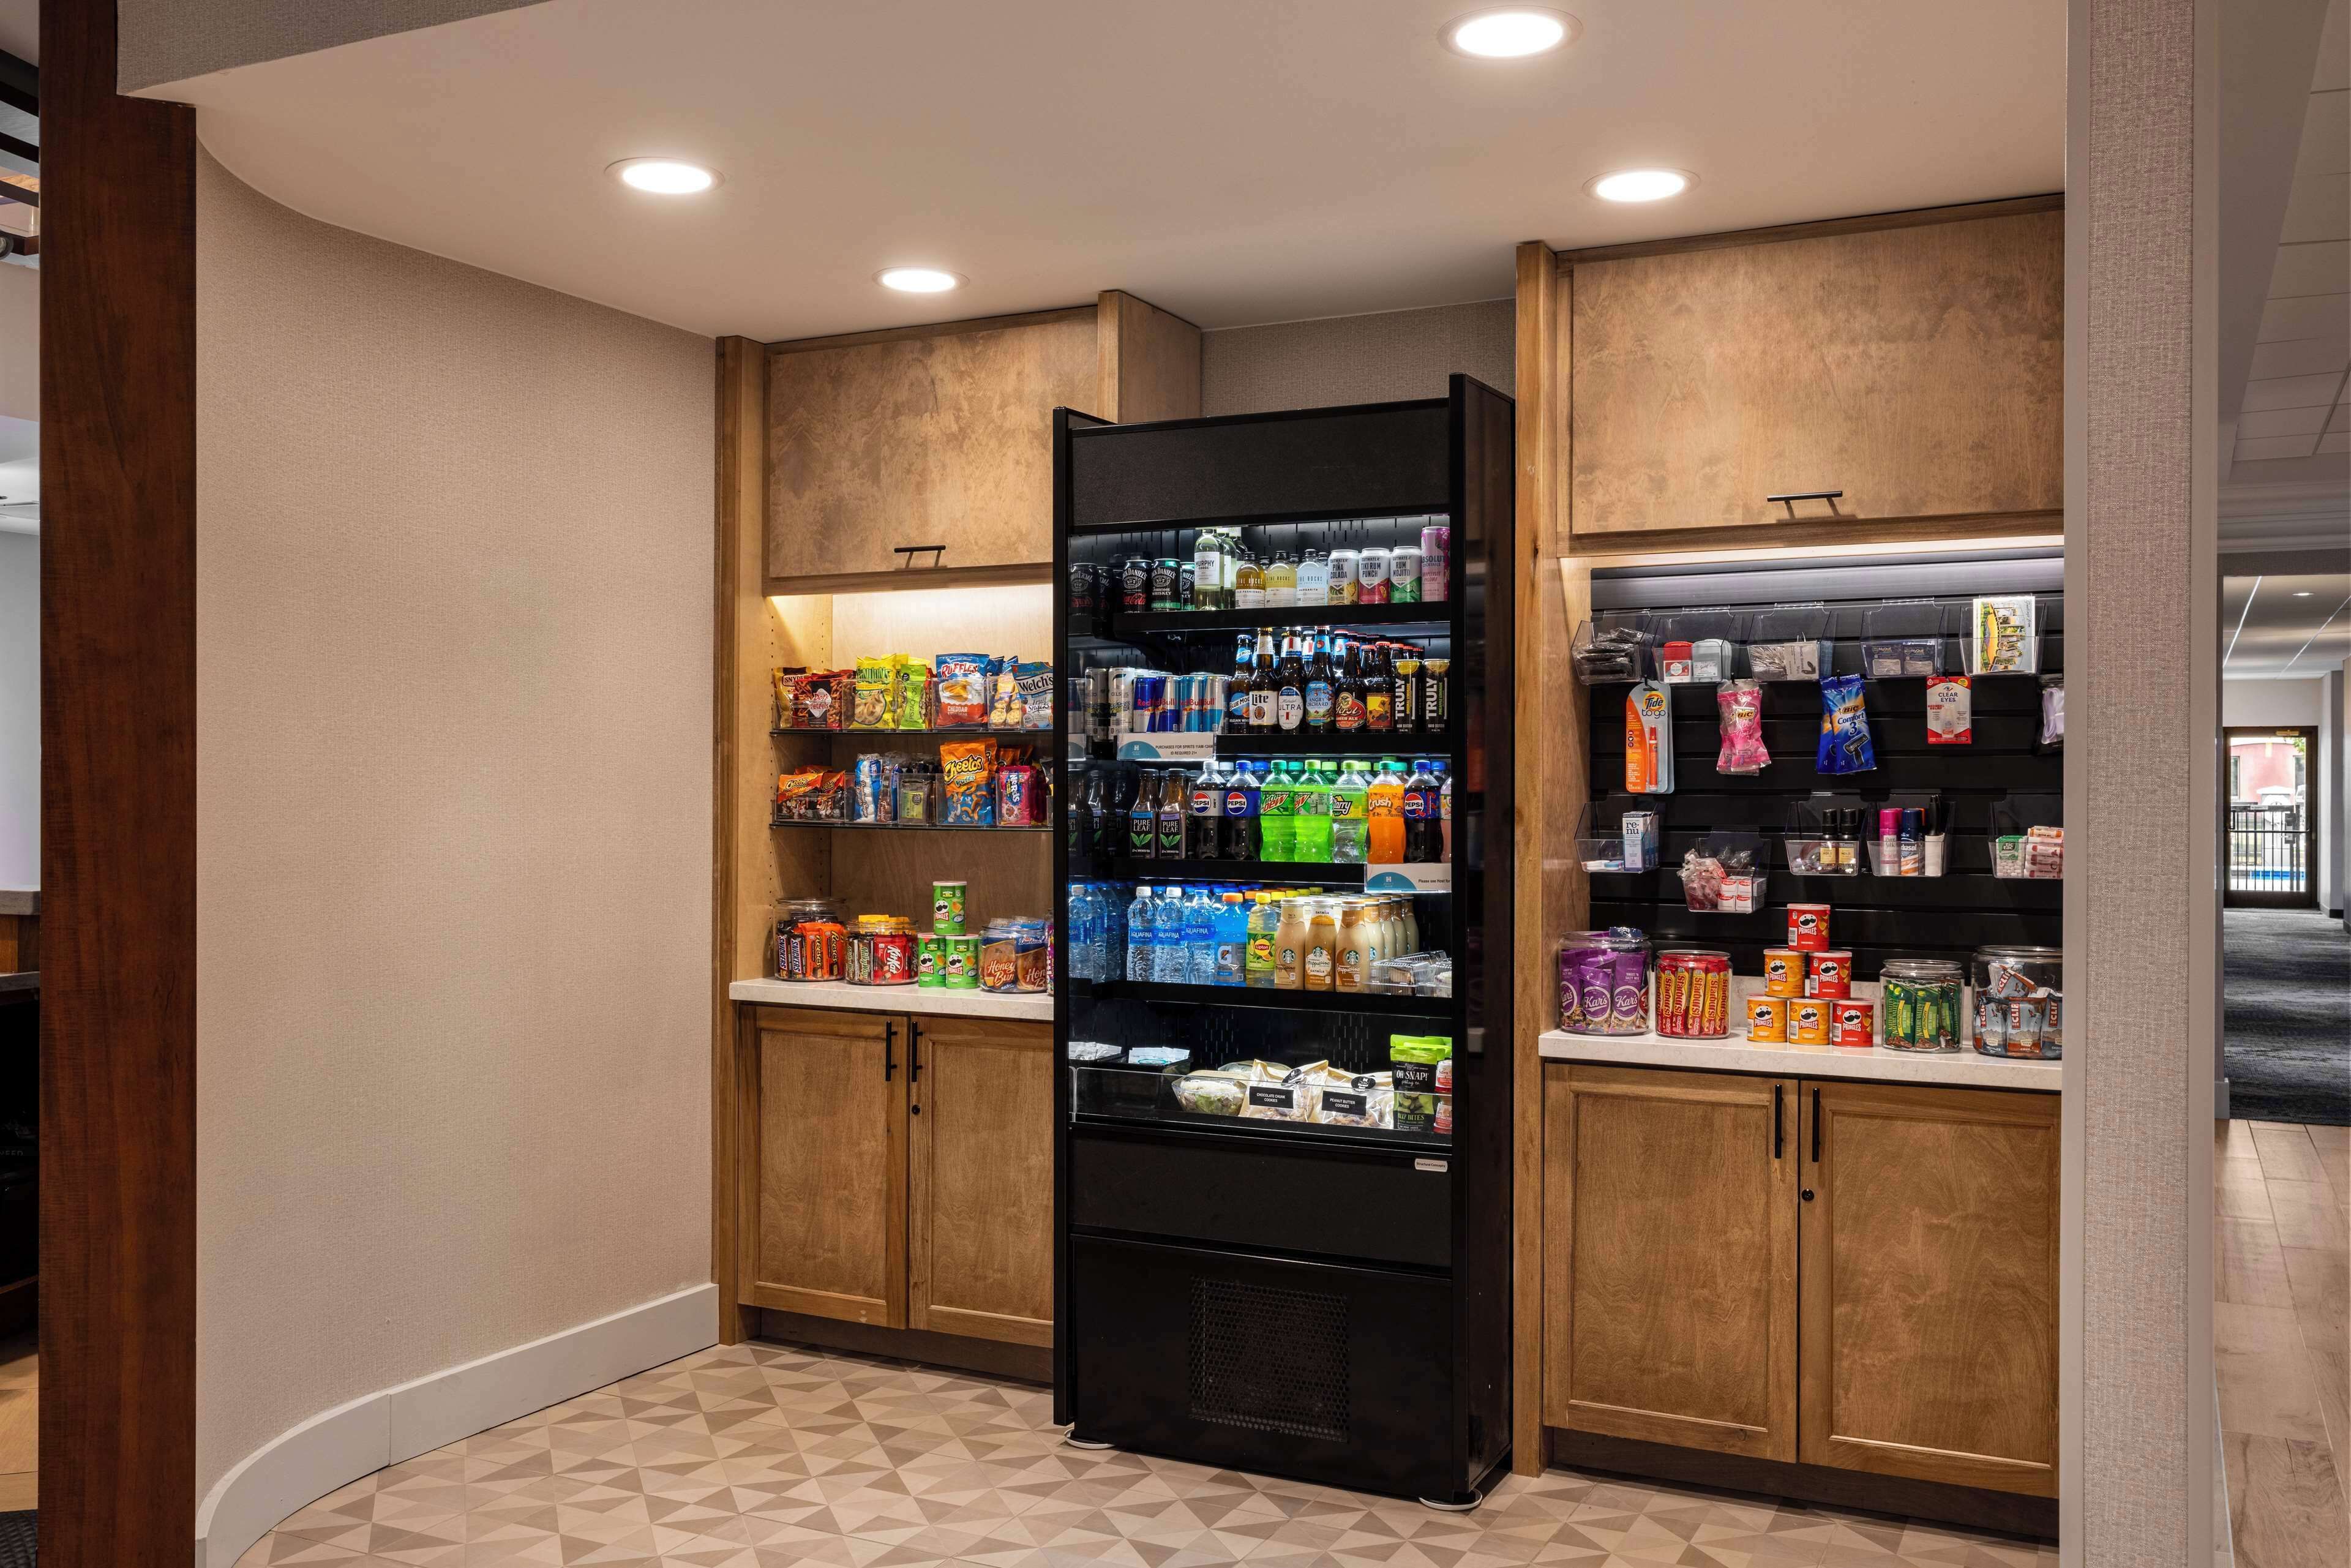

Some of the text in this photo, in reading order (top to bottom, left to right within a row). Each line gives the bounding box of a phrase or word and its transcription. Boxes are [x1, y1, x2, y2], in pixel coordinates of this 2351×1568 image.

[1157, 567, 1176, 579] DANIEL'S
[1332, 562, 1344, 571] PIÑA
[1128, 568, 1147, 581] DANIEL'S
[940, 662, 979, 679] RUFFLES
[1018, 675, 1053, 692] Welch's
[1252, 694, 1269, 706] Lite
[1396, 678, 1405, 720] TRULY
[1426, 678, 1438, 720] TRULY
[1645, 697, 1664, 710] Tide
[1229, 701, 1239, 711] BLUE
[1654, 710, 1666, 719] go
[1837, 711, 1865, 725] Comfort
[1850, 721, 1858, 735] 3
[944, 754, 983, 783] Cheetos
[786, 778, 808, 790] Cheetos
[1263, 794, 1288, 812] DEW
[1369, 797, 1392, 811] Crush
[1158, 931, 1180, 939] AQUAFINA
[1798, 927, 1817, 936] PRINGLES
[778, 936, 787, 970] SNICKERS
[791, 939, 801, 973] SNICKERS
[860, 947, 870, 979] Milky Way
[988, 960, 1016, 973] Honey
[994, 971, 1014, 986] Bun
[1769, 973, 1787, 982] PRINGLES
[1820, 974, 1839, 983] PRINGLES
[1998, 970, 2011, 988] CLIF
[1615, 995, 1638, 1008] Kar's
[1663, 977, 1672, 1017] Starburst
[1674, 975, 1685, 1015] Starburst
[1692, 977, 1703, 1016] Starburst
[1708, 980, 1719, 1019] Starburst
[1584, 996, 1608, 1008] Kar's
[1754, 1018, 1773, 1027] PRINGLES
[1799, 1021, 1818, 1029] PRINGLES
[1842, 1024, 1861, 1032] PRINGLES
[1396, 1070, 1428, 1081] OH SNAP!
